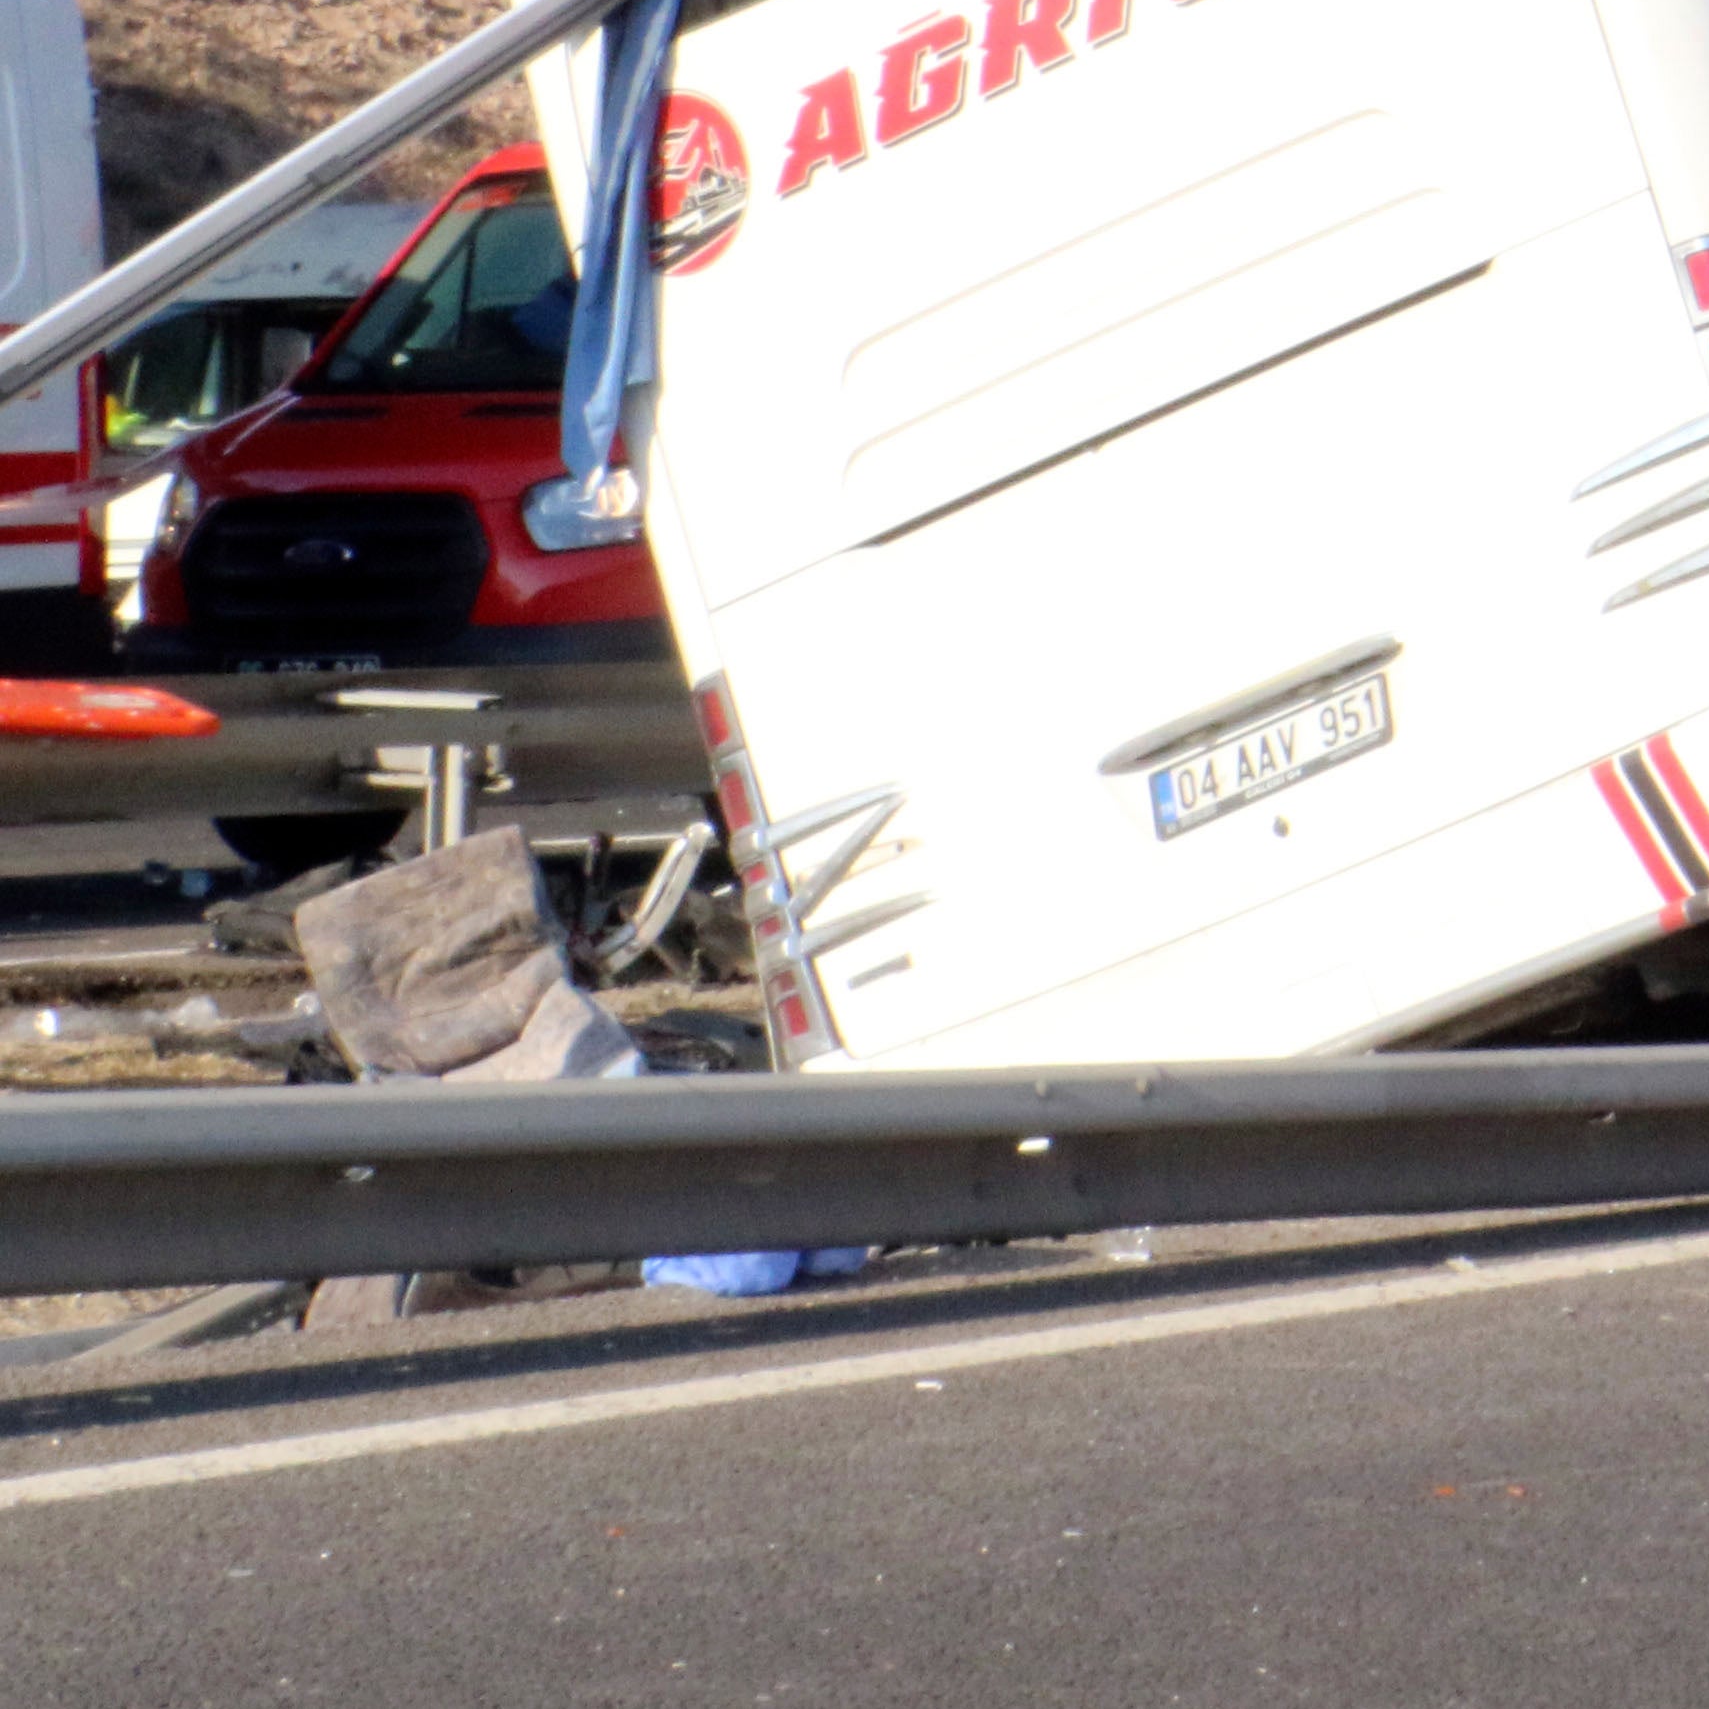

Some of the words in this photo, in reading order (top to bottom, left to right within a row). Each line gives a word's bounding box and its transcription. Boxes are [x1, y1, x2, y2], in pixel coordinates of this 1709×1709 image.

[1177, 756, 1219, 810] 04
[1236, 721, 1296, 785] AAV
[1319, 688, 1378, 747] 951
